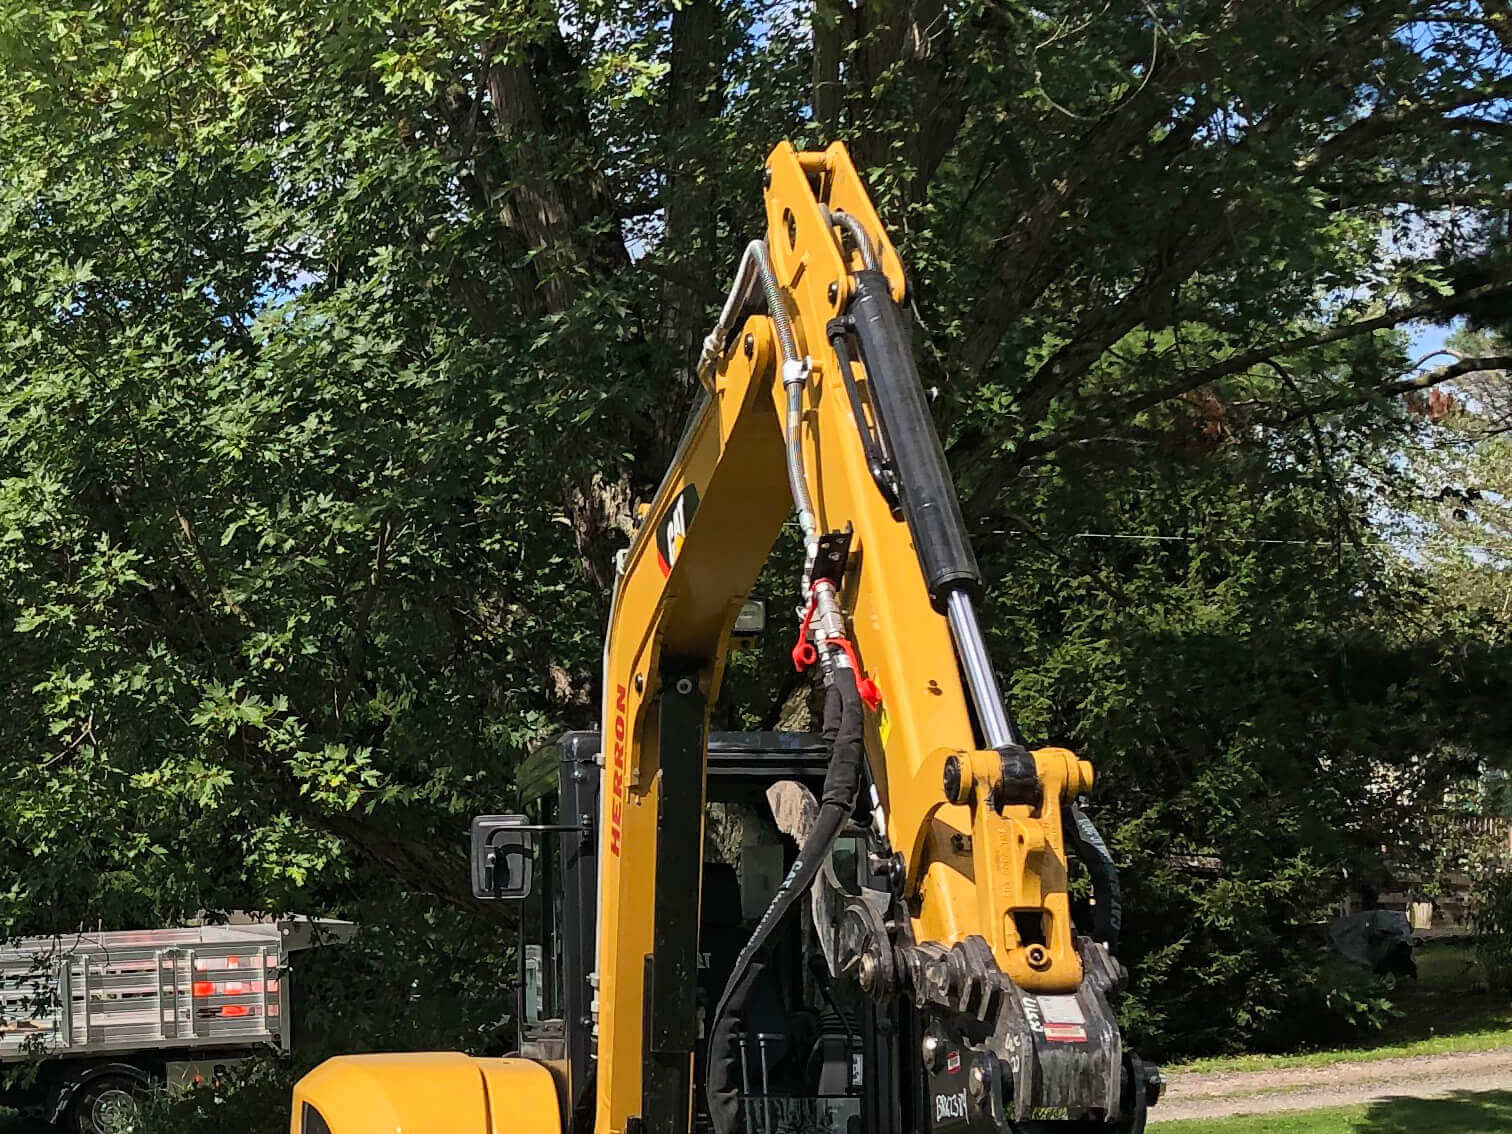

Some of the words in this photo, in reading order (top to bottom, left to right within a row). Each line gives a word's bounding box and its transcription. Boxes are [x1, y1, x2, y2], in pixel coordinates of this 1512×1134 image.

[667, 493, 686, 568] CAT
[610, 685, 626, 858] HERRON
[781, 860, 804, 889] CAT
